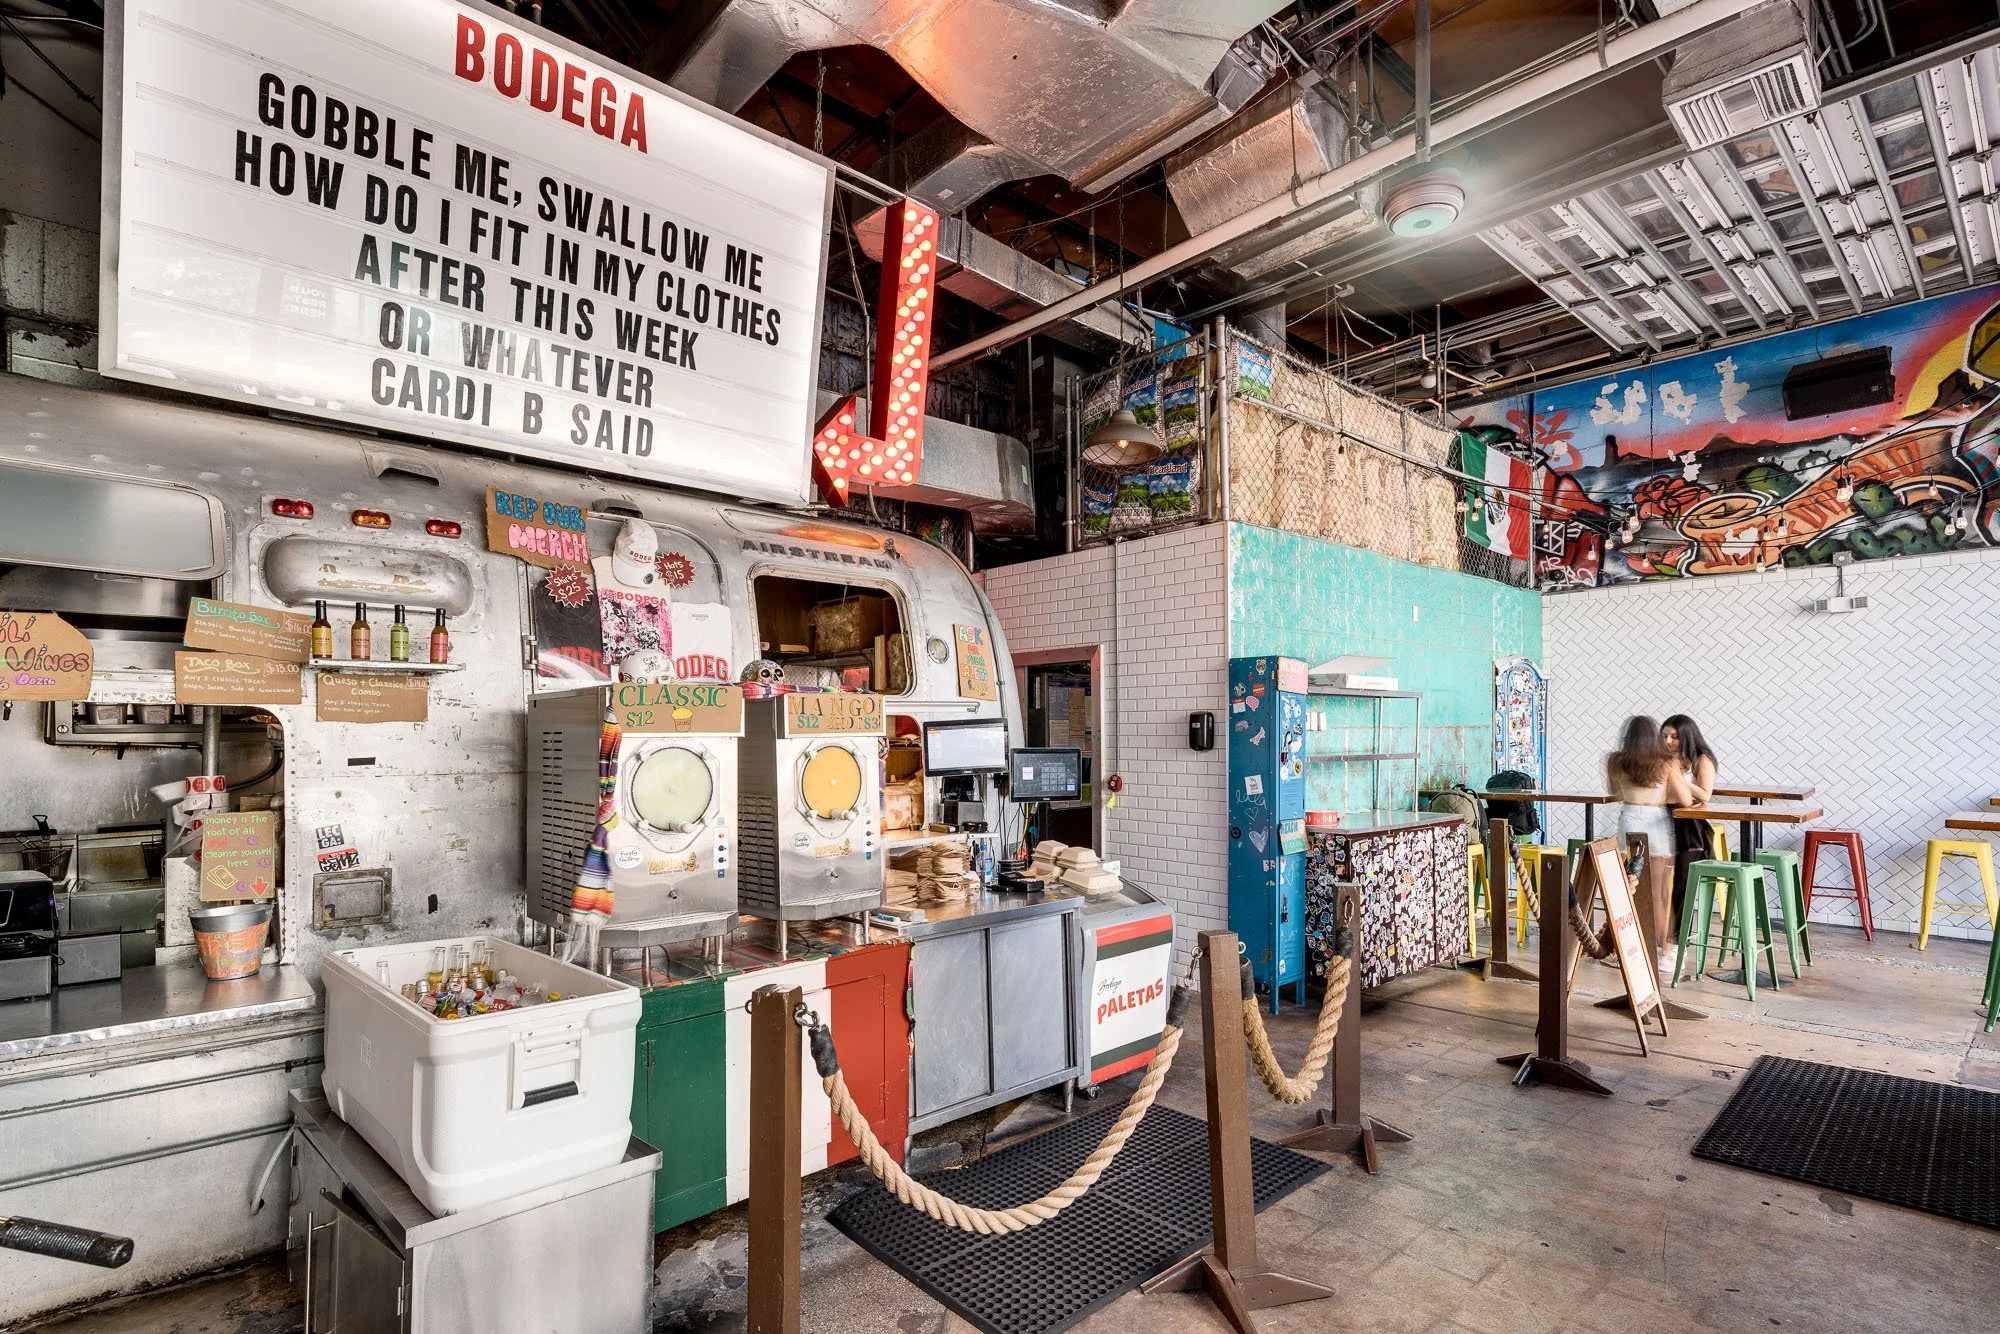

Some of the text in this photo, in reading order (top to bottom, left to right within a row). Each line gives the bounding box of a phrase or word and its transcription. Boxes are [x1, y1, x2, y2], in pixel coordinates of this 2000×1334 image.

[455, 13, 648, 154] BODEGA
[258, 72, 763, 293] GOBBLE ME, SWALLOW ME
[235, 129, 781, 346] HOW DO I FIT IN MY CLOTHES
[354, 233, 700, 370] AFTER THIS WEEK
[379, 300, 654, 409] OR WHATEVER
[371, 357, 654, 458] CARDI B SAID
[495, 491, 586, 532] REP OUR
[508, 523, 589, 565] MERCH
[742, 539, 893, 570] AIRSTREAM
[664, 561, 684, 570] Hats
[666, 570, 685, 581] $15
[558, 582, 581, 600] $25
[197, 601, 246, 619] Burrito
[249, 612, 269, 623] Box
[959, 625, 983, 645] ASK
[184, 657, 220, 667] TACO
[265, 662, 299, 674] $13.00
[323, 675, 357, 686] Queso
[351, 688, 381, 697] Combo
[619, 683, 729, 708] CLASSIC
[788, 696, 875, 717] MANGO
[626, 711, 655, 728] $12
[797, 715, 819, 729] $12
[317, 825, 340, 840] LEC
[227, 859, 248, 867] here
[1097, 977, 1164, 1025] PALETAS
